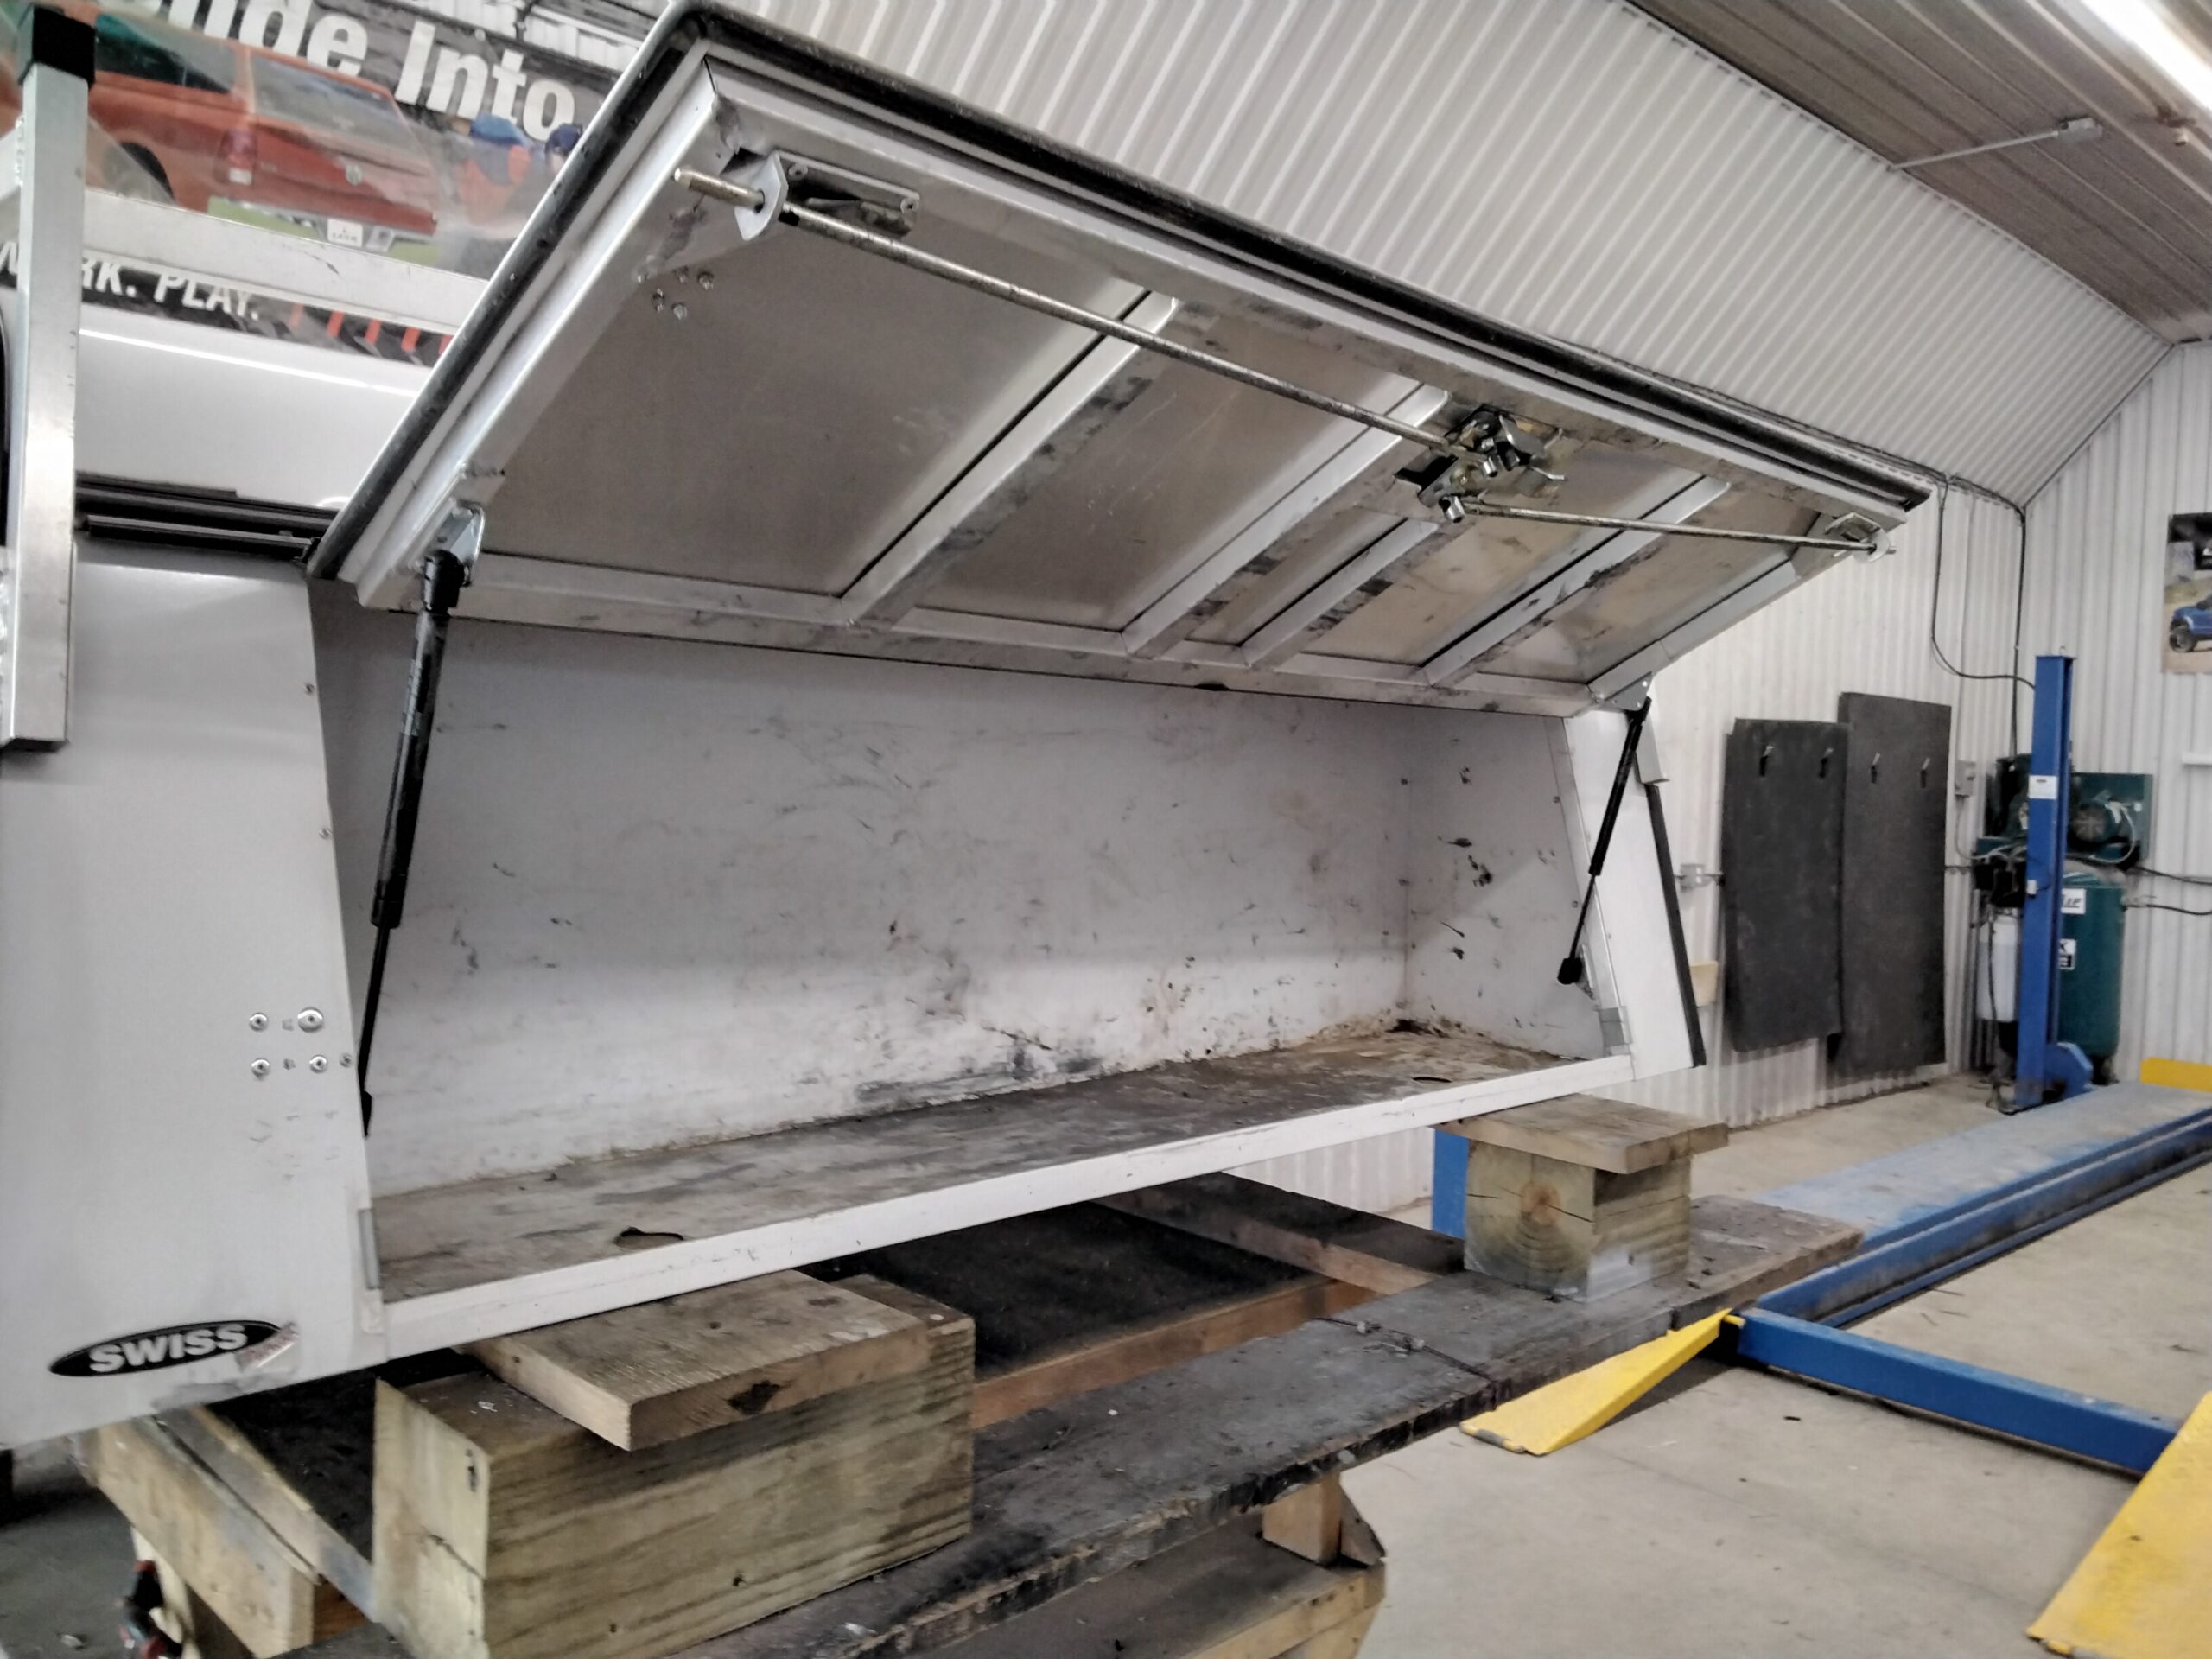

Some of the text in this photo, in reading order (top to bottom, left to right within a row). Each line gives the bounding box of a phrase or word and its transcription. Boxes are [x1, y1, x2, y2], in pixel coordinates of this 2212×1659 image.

[394, 19, 575, 143] Into
[153, 272, 259, 321] PLAY.
[89, 1323, 247, 1372] SWISS
